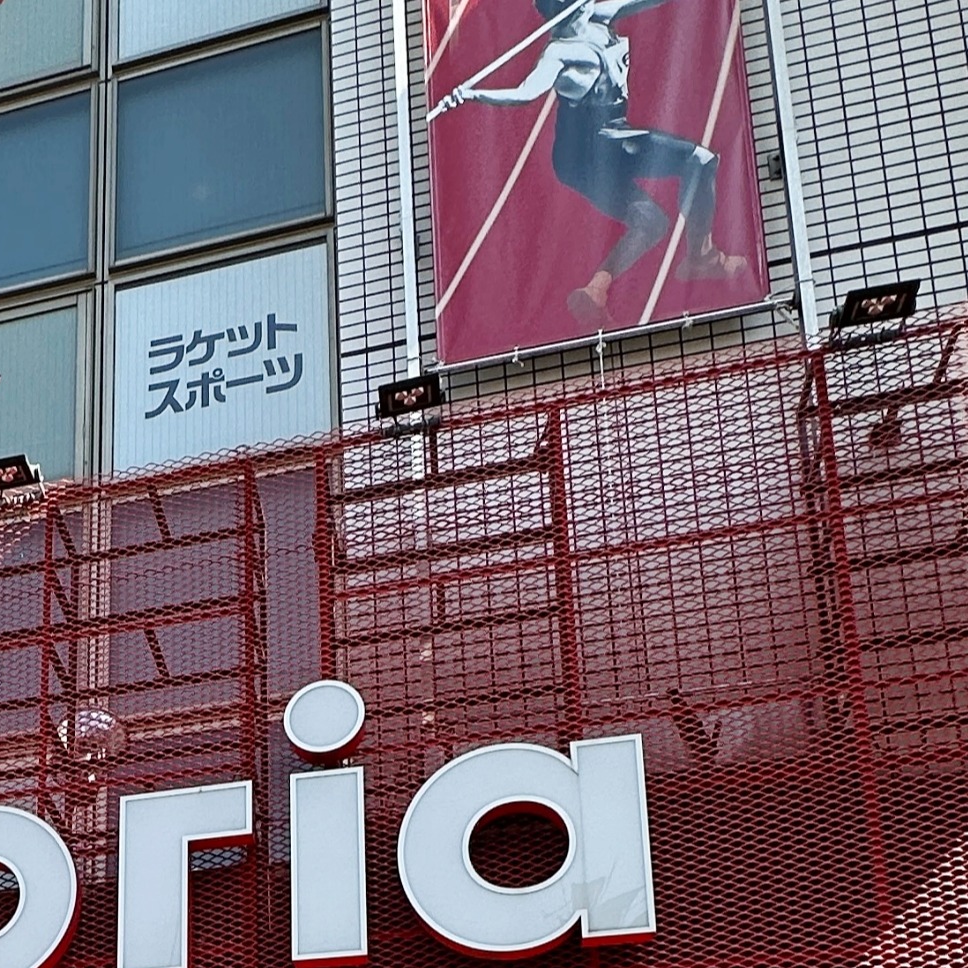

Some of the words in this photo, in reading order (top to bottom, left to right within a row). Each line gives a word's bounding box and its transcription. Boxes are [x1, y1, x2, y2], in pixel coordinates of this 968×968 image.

[148, 313, 298, 375] ラケット
[144, 353, 304, 420] スポーツ
